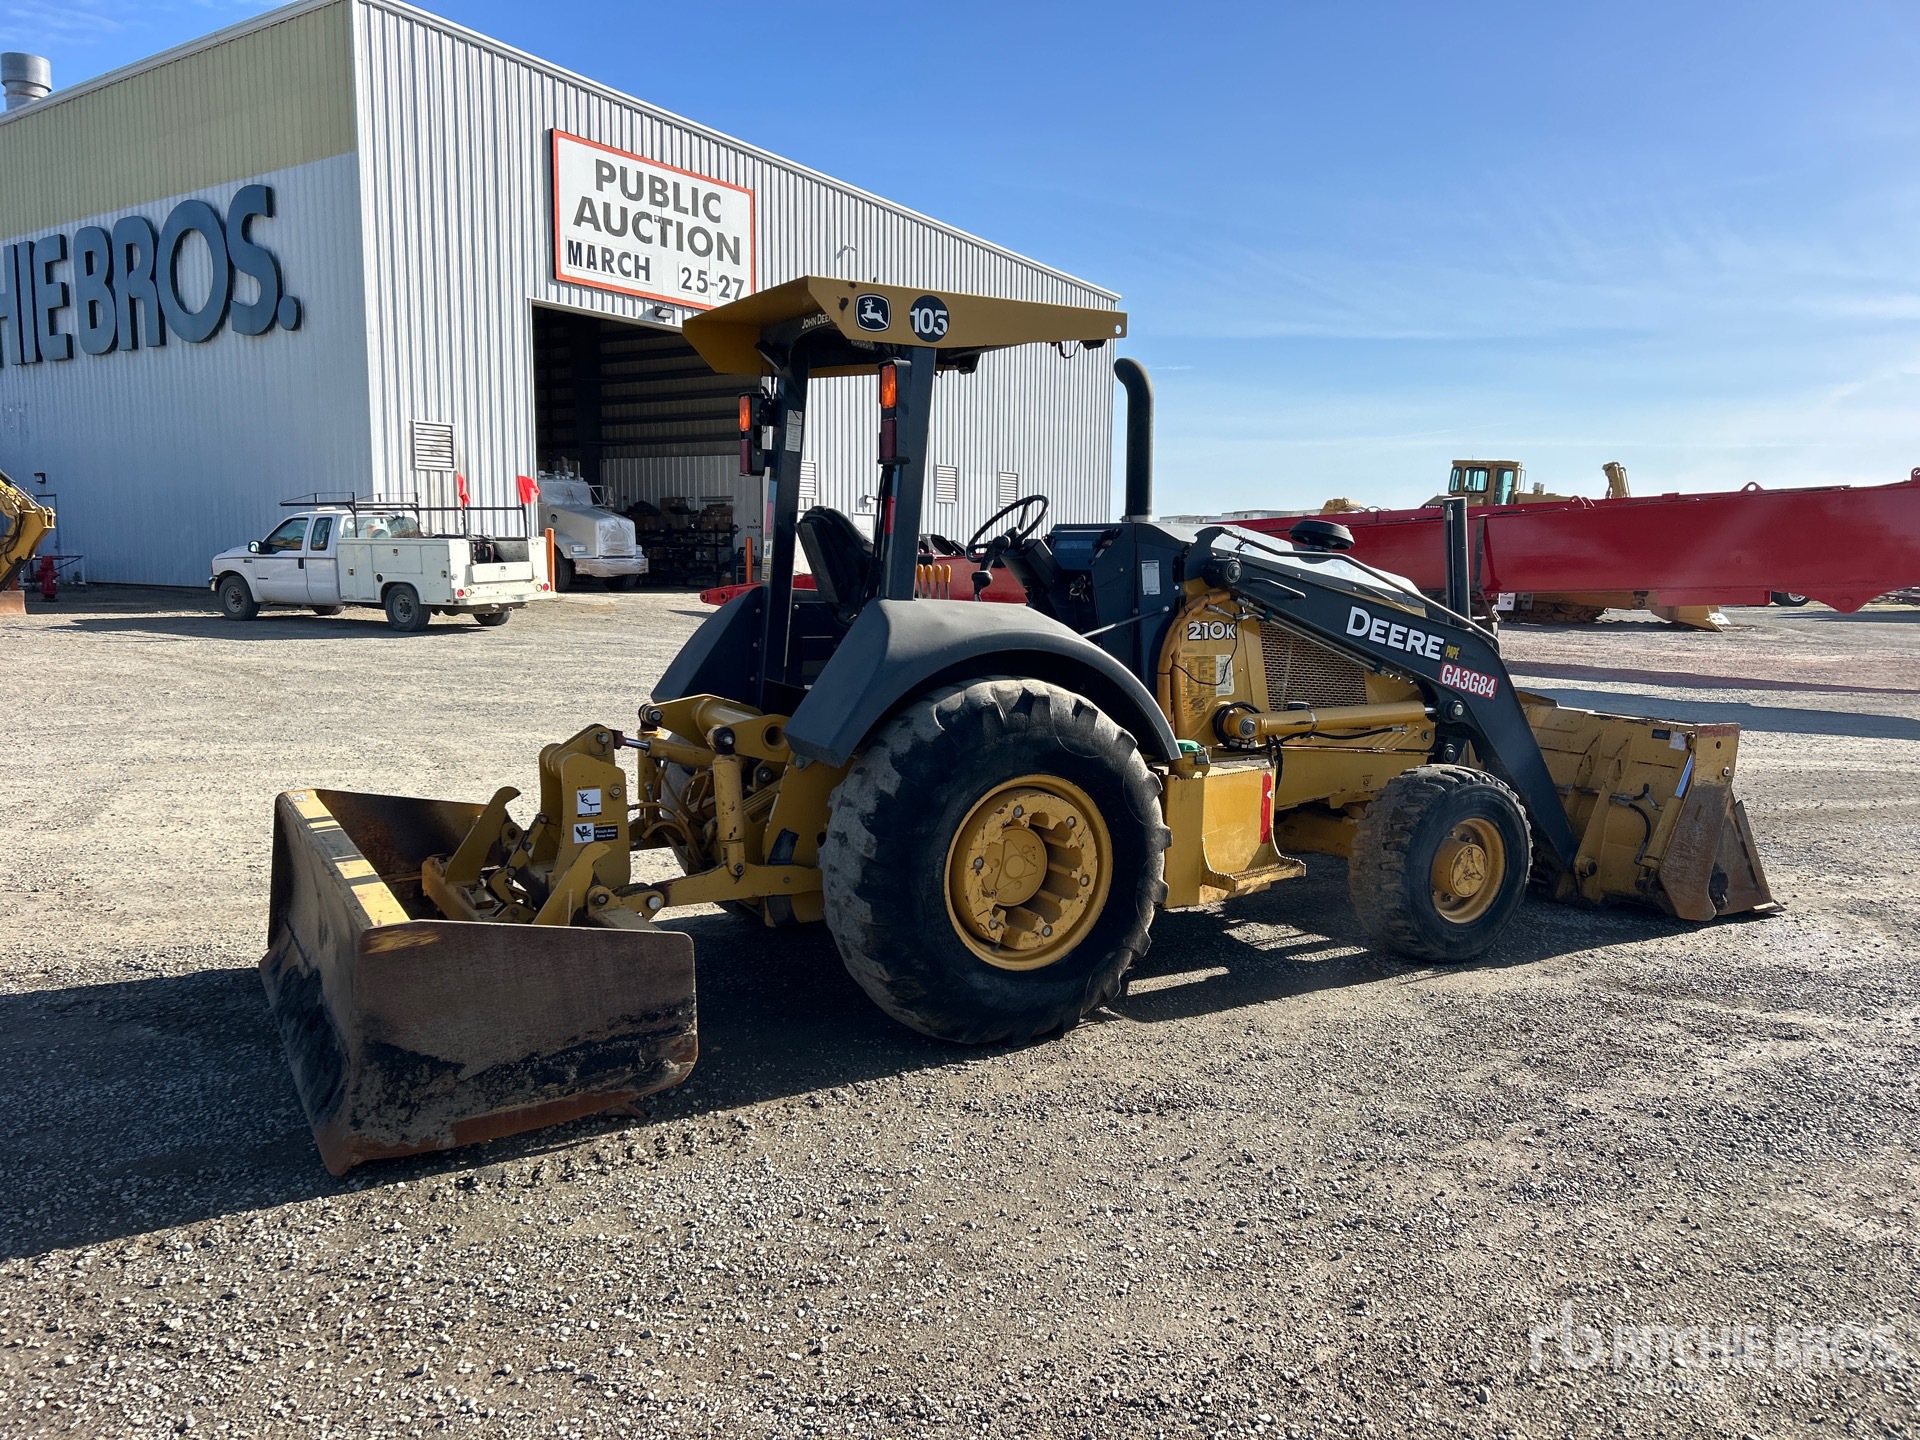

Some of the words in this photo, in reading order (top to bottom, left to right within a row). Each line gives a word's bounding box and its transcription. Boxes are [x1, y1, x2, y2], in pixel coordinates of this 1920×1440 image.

[595, 158, 722, 224] PUBLIC
[572, 195, 741, 266] AUCTION
[73, 184, 302, 356] BROS.
[567, 239, 651, 282] MARCH
[680, 266, 745, 300] 25-27
[801, 316, 817, 330] JOHN
[817, 313, 831, 325] DEE
[909, 307, 948, 336] 105
[1187, 620, 1237, 641] 210K
[1346, 605, 1445, 661] DEERE
[1440, 664, 1497, 698] GA3G84
